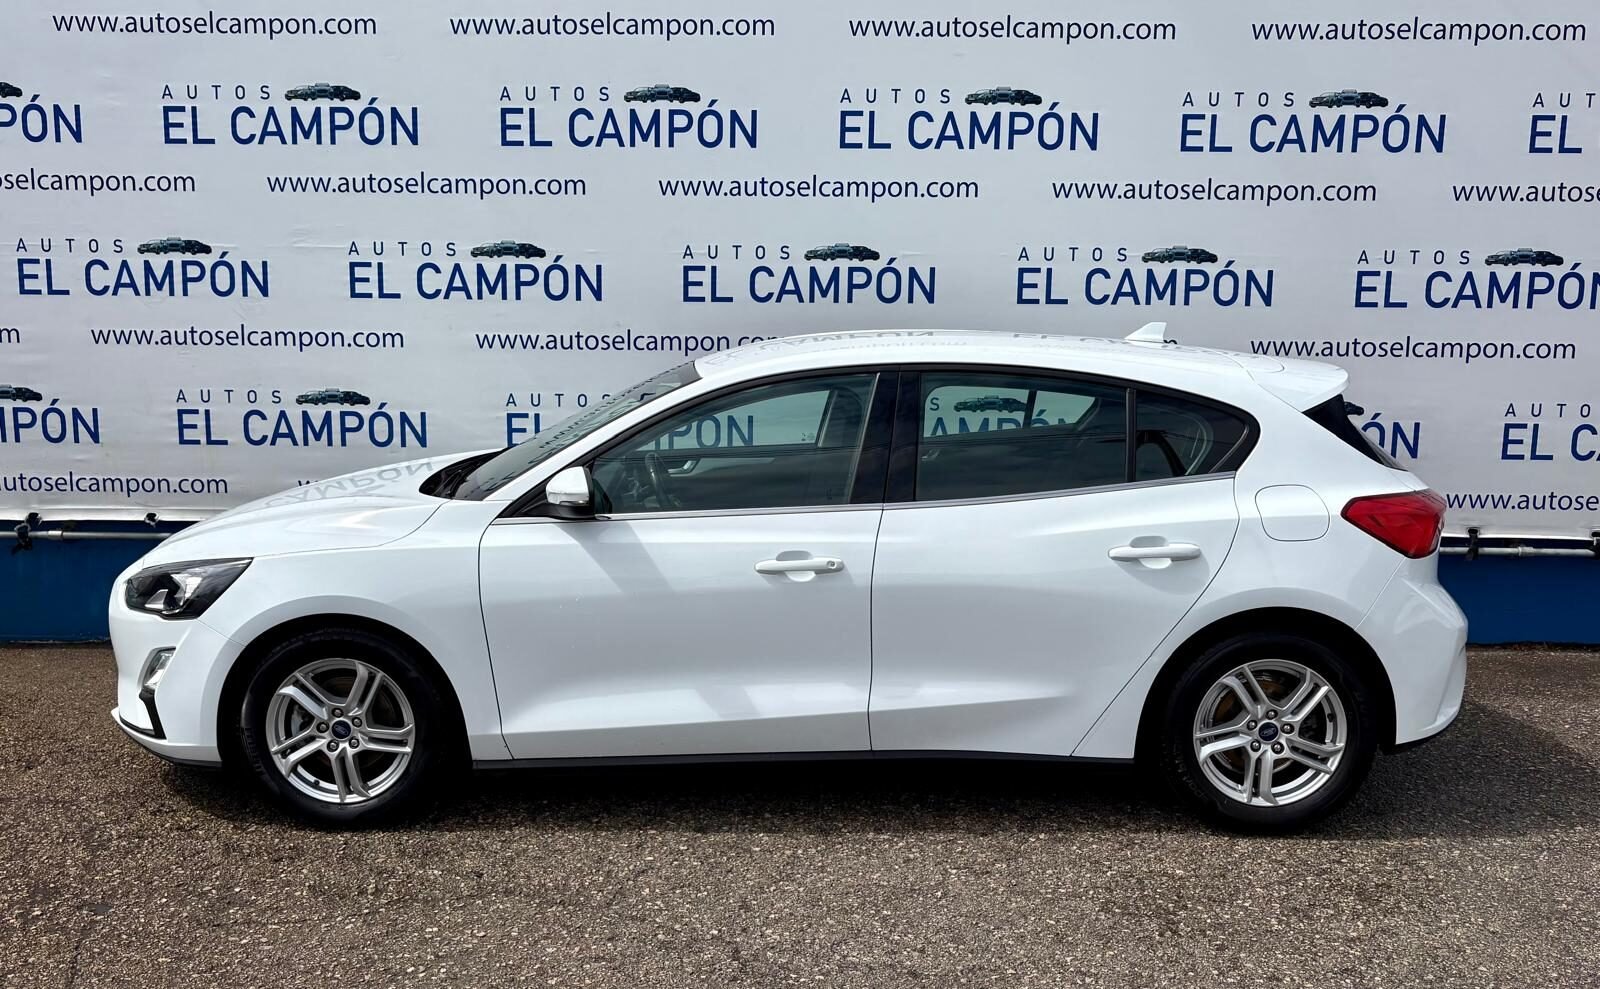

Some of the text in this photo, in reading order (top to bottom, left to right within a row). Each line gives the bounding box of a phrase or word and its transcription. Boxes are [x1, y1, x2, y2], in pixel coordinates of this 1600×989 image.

[53, 11, 377, 41] www.autoselcampon.com
[450, 12, 775, 42] www.autoselcampon.com
[849, 15, 1176, 46] www.autoselcampon.com
[1252, 17, 1586, 47] www.autoselcampon.com
[162, 84, 271, 100] AUTOS
[500, 86, 610, 102] AUTOS
[840, 88, 951, 104] AUTOS
[1182, 92, 1295, 107] AUTOS
[163, 97, 419, 145] EL CAMPÓN
[500, 100, 758, 149] EL CAMPÓN
[840, 103, 1099, 152] EL CAMPÓN
[1179, 105, 1447, 154] EL CAMPÓN
[1528, 114, 1583, 154] EL
[0, 168, 196, 197] selcampon.com
[267, 171, 586, 200] www.autoselcampon.com
[659, 175, 979, 204] www.autoselcampon.com
[1052, 178, 1377, 207] www.autoselcampon.com
[16, 238, 124, 254] AUTOS
[348, 241, 457, 257] AUTOS
[682, 244, 790, 260] AUTOS
[1018, 247, 1128, 263] AUTOS
[1357, 250, 1470, 265] AUTOS
[17, 251, 270, 298] EL CAMPÓN
[349, 255, 603, 302] EL CAMPÓN
[683, 258, 936, 305] EL CAMPÓN
[1017, 260, 1274, 308] EL CAMPÓN
[1354, 271, 1408, 309] EL
[91, 323, 404, 353] www.autoselcampon.com
[1250, 335, 1576, 364] www.autoselcampon.com
[176, 388, 282, 404] AUTOS
[0, 398, 101, 445] PÓN
[177, 402, 428, 448] EL CAMPÓN
[1501, 423, 1554, 461] EL
[0, 471, 228, 498] utoselcampon.com
